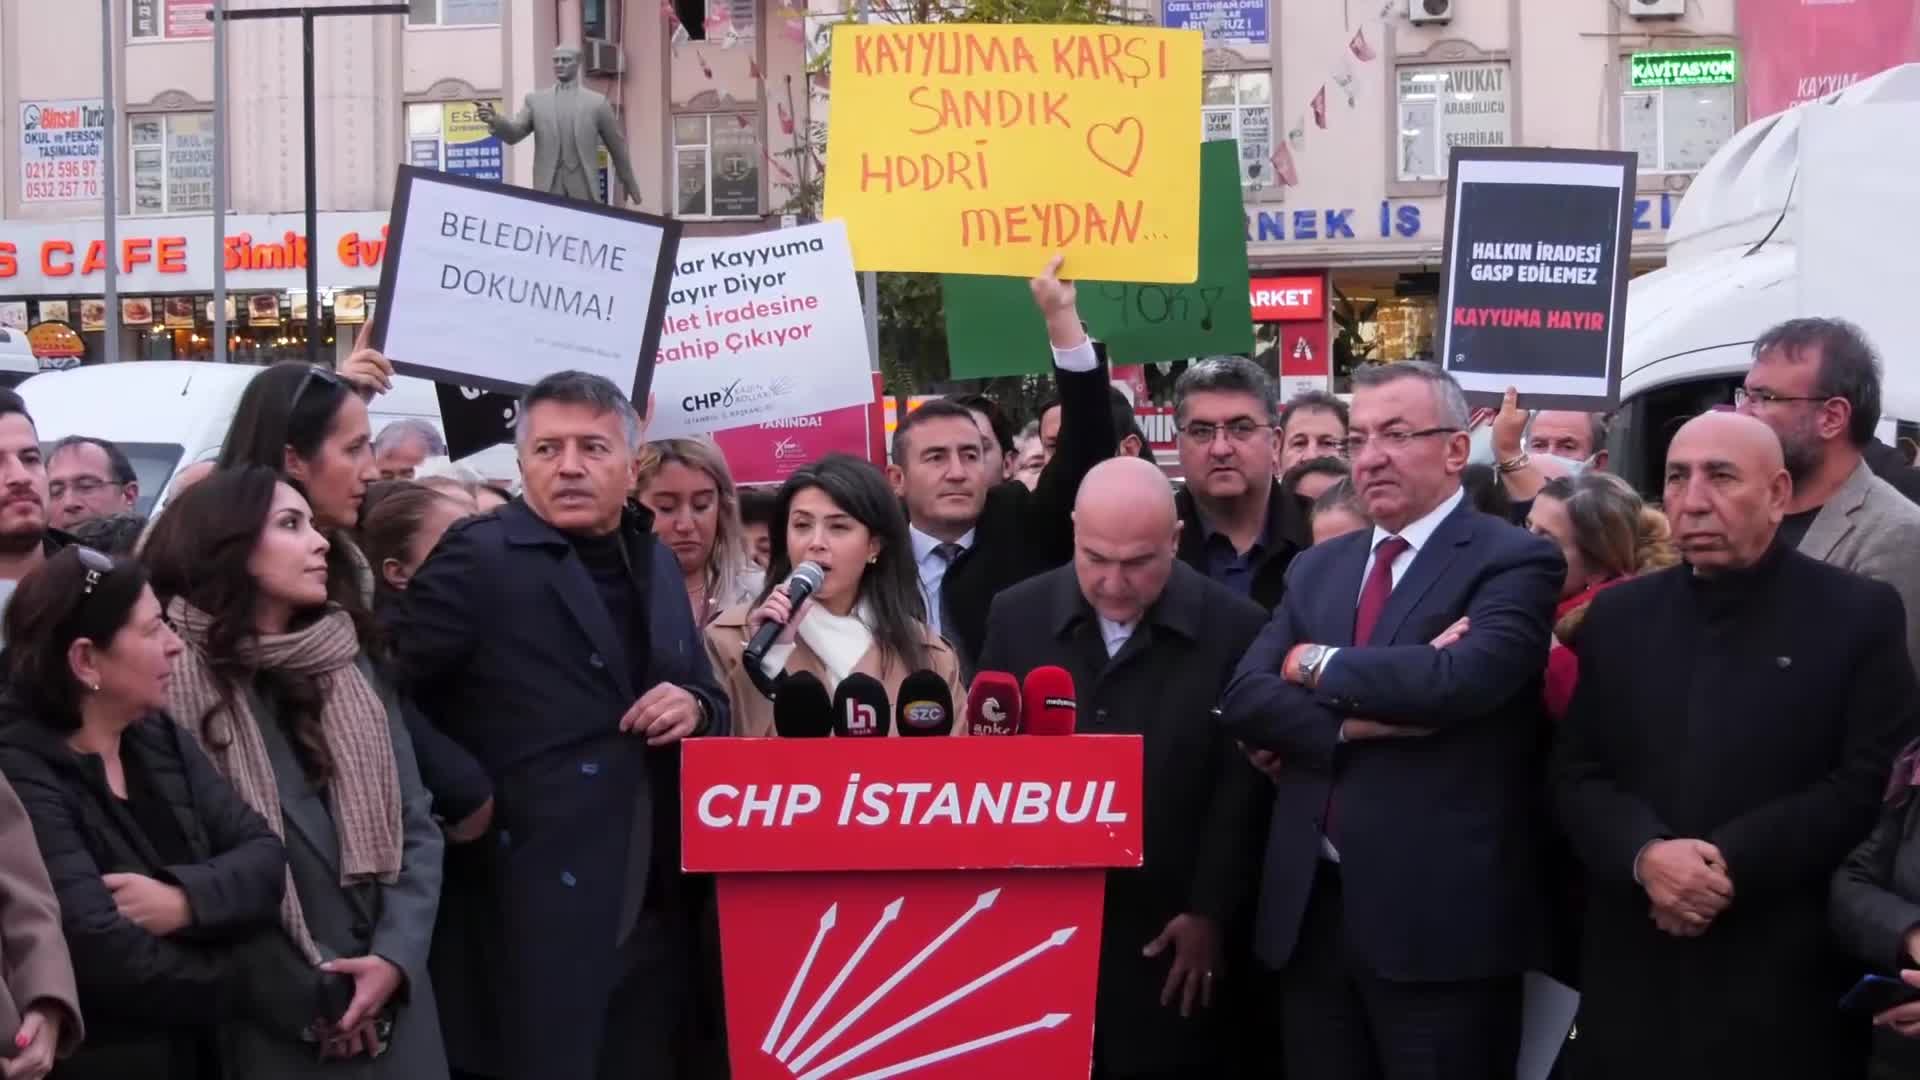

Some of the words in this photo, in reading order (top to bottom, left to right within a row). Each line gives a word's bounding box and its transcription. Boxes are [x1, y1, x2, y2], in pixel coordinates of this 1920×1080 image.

[855, 31, 1038, 77] KAYYUMA
[1052, 33, 1167, 88] KARŞI
[1444, 68, 1504, 92] AVUKAT
[908, 85, 1071, 134] SANDIK
[24, 132, 50, 144] OKUL
[65, 130, 104, 143] PERSON
[26, 161, 55, 179] 0212
[58, 160, 79, 178] 596
[26, 181, 55, 198] 0532
[58, 181, 79, 197] 257
[40, 237, 187, 277] CAFE
[440, 211, 627, 272] BELEDİYEME
[710, 237, 825, 269] Kayyuma
[1471, 242, 1533, 261] HALKIN
[1535, 240, 1602, 264] İRADESİ
[667, 282, 718, 306] ayır
[723, 271, 787, 294] Diyor
[1470, 264, 1515, 282] GASP
[1517, 262, 1598, 285] EDİLEMEZ
[440, 264, 615, 321] DOKUNMA!
[704, 294, 819, 328] İradesine
[1453, 307, 1542, 329] KAYYUMA
[1546, 309, 1605, 331] HAYIR
[725, 321, 813, 354] Çıkıyor
[681, 391, 722, 413] CHP
[909, 707, 942, 721] SZC
[697, 783, 822, 828] CHP
[837, 773, 1130, 826] İSTANBUL
